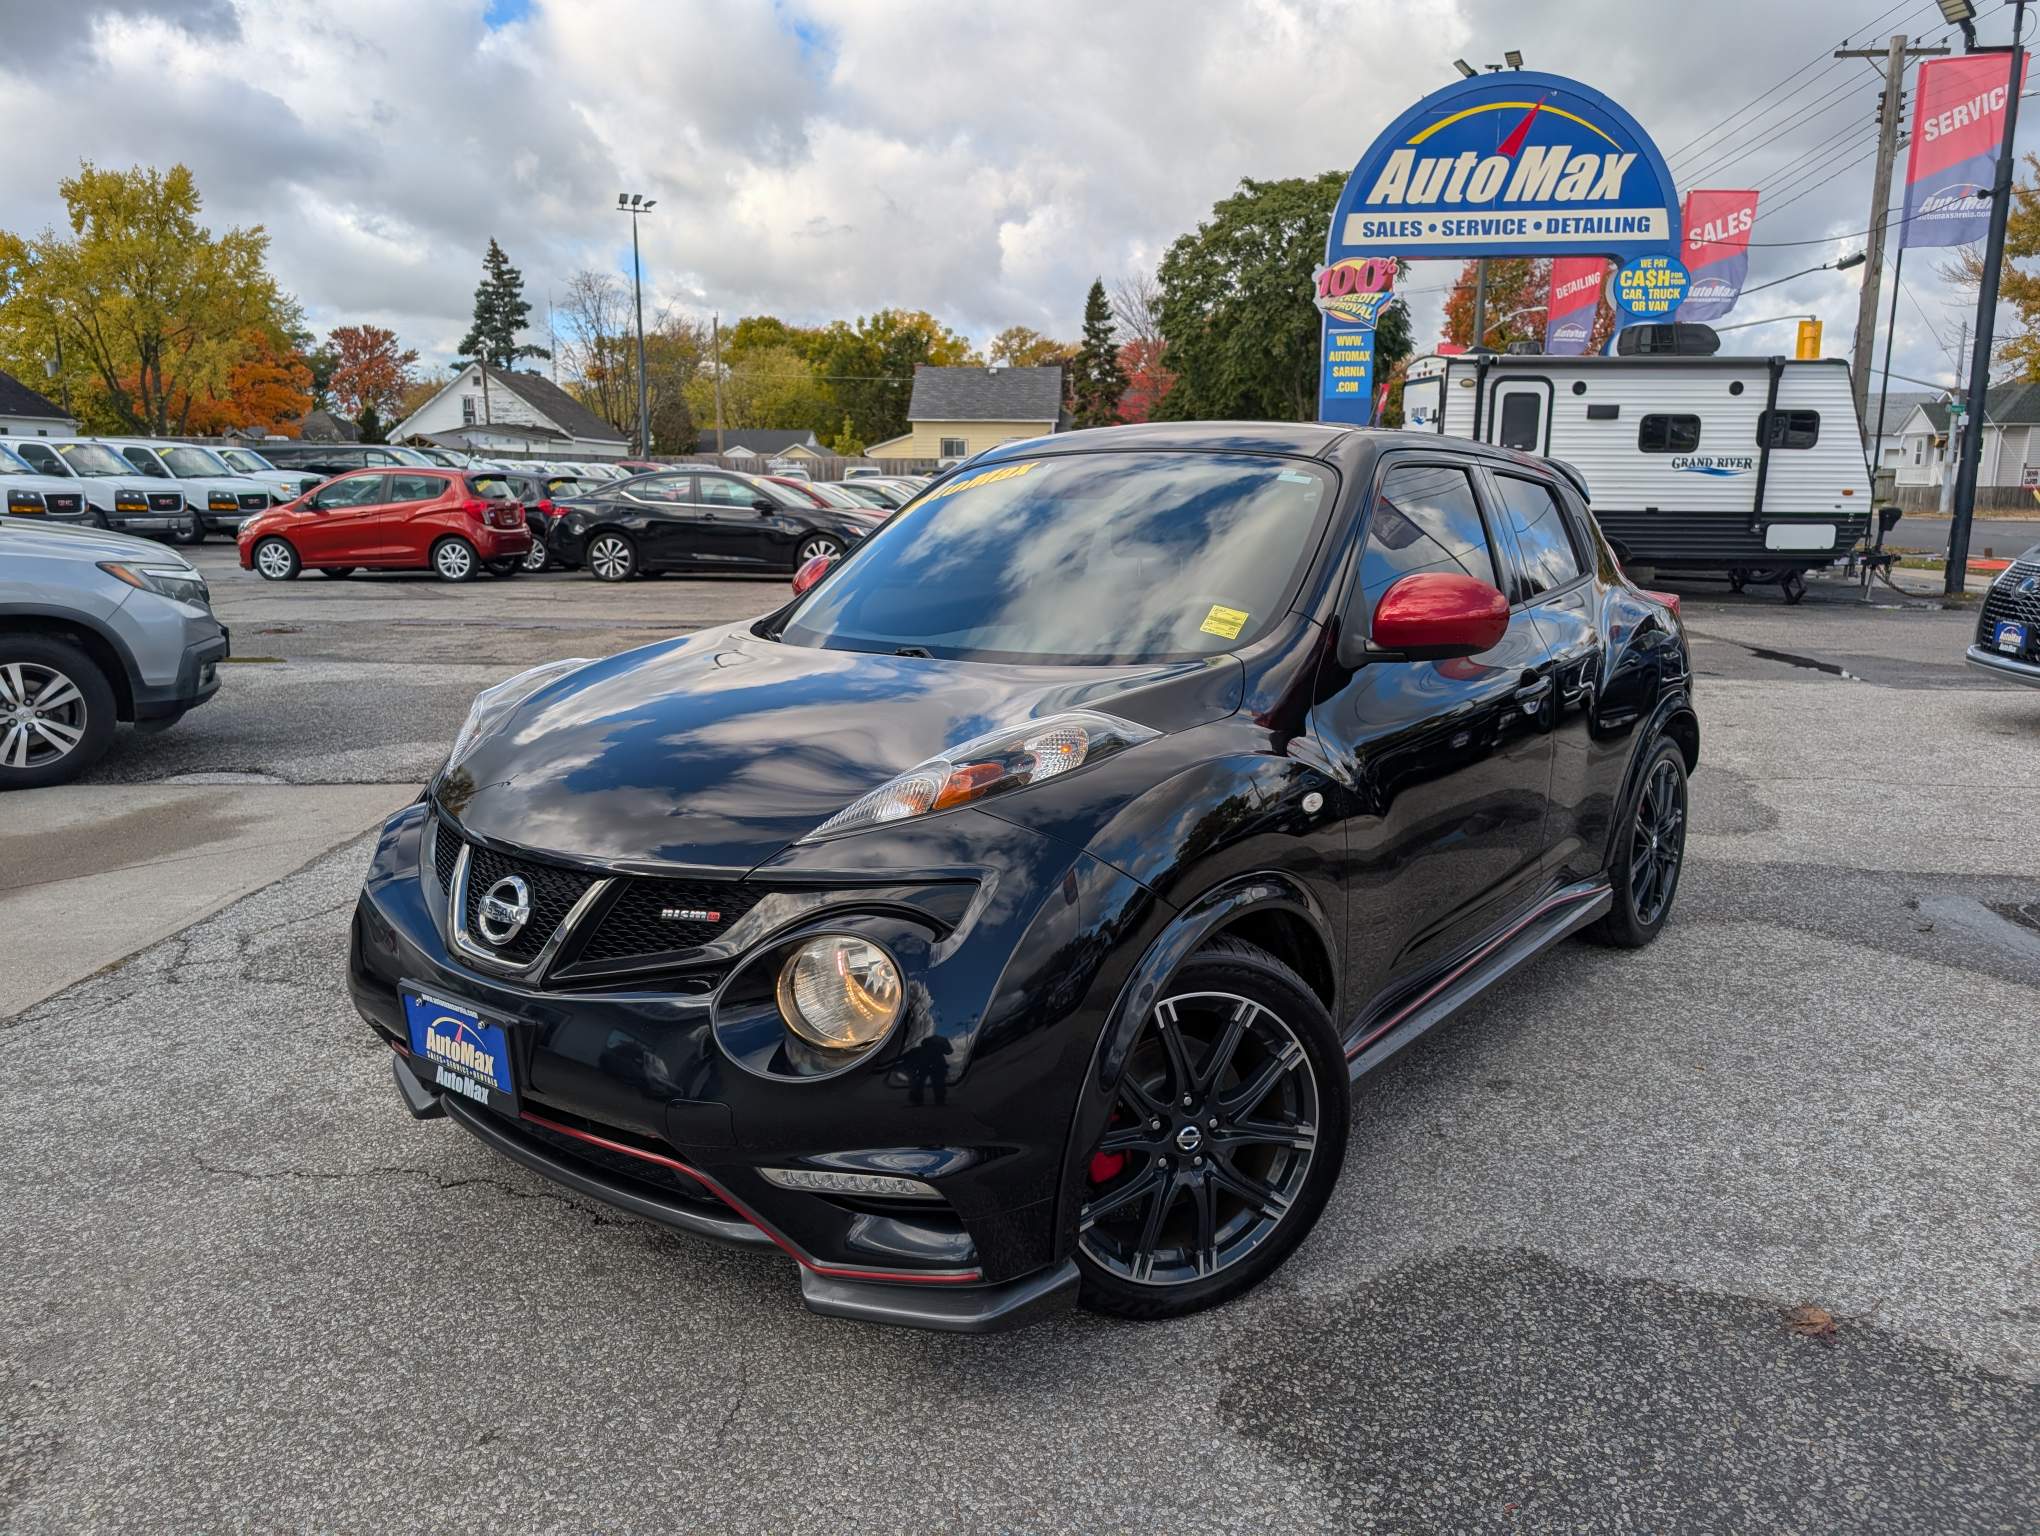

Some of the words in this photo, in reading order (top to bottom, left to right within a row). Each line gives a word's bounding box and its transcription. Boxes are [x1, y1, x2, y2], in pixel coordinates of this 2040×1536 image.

[1924, 84, 2009, 142] SERVIC
[1365, 145, 1637, 205] AutoMax
[1363, 220, 1422, 238] SALES
[1442, 218, 1527, 236] SERVICE
[1546, 216, 1650, 235] DETAILING
[1689, 208, 1752, 250] SALES
[1641, 259, 1652, 268] WE
[1654, 259, 1668, 268] PAY
[1318, 257, 1397, 297] 100%
[1556, 272, 1600, 300] DETAILING
[1620, 268, 1671, 288] CA$H
[1648, 288, 1680, 299] TRUCK
[1632, 301, 1645, 311] OR
[1648, 301, 1668, 311] VAN
[1329, 351, 1370, 361] AUTOMAX
[1333, 367, 1365, 377] SARNIA
[1336, 381, 1358, 392] .COM
[1672, 456, 1713, 469] GRAND
[1717, 457, 1752, 469] RIVER
[479, 897, 522, 922] NISSAN
[426, 1027, 494, 1076] AutoMax
